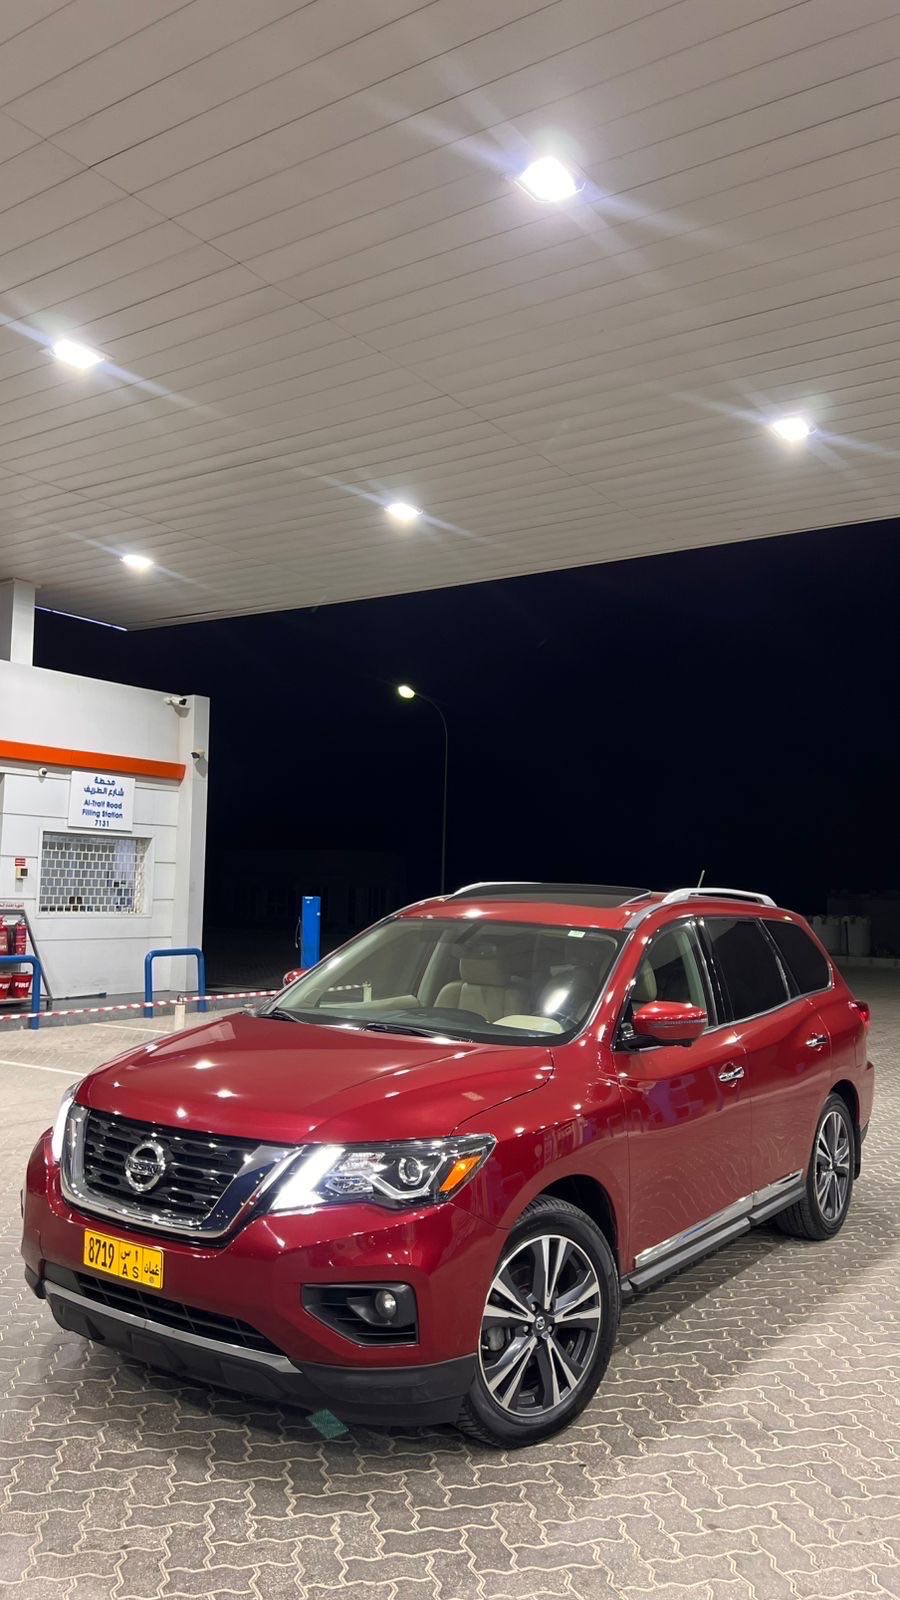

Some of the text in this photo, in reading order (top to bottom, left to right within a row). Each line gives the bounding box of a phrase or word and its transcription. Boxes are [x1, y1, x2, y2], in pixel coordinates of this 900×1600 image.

[94, 776, 116, 786] محطة
[107, 787, 124, 797] شارع
[106, 801, 122, 810] Road
[82, 808, 123, 819] Filling Station
[95, 819, 109, 827] 7131
[88, 1236, 115, 1269] 8719
[122, 1263, 139, 1279] A S
